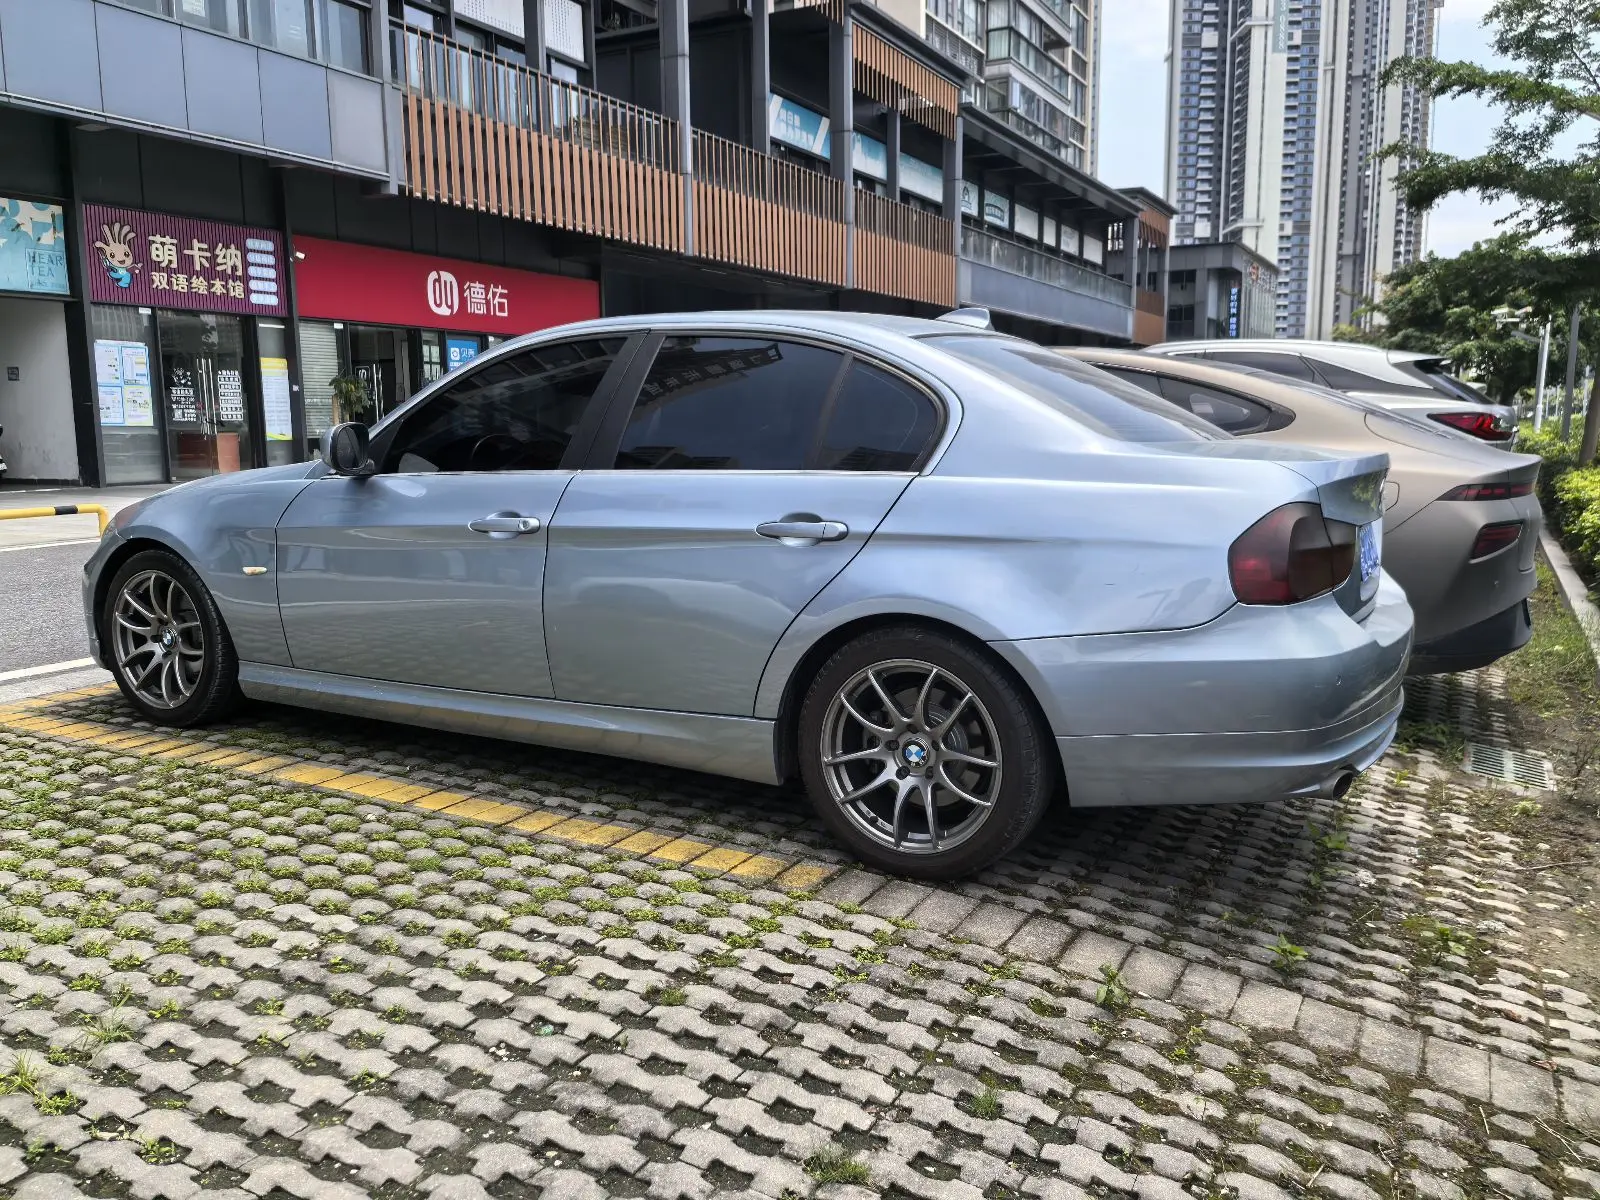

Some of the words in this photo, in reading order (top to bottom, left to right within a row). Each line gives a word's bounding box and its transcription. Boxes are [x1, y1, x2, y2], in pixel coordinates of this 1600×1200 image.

[148, 234, 243, 276] 萌卡纳
[151, 271, 245, 299] 双语绘本馆
[463, 280, 508, 317] 德佑
